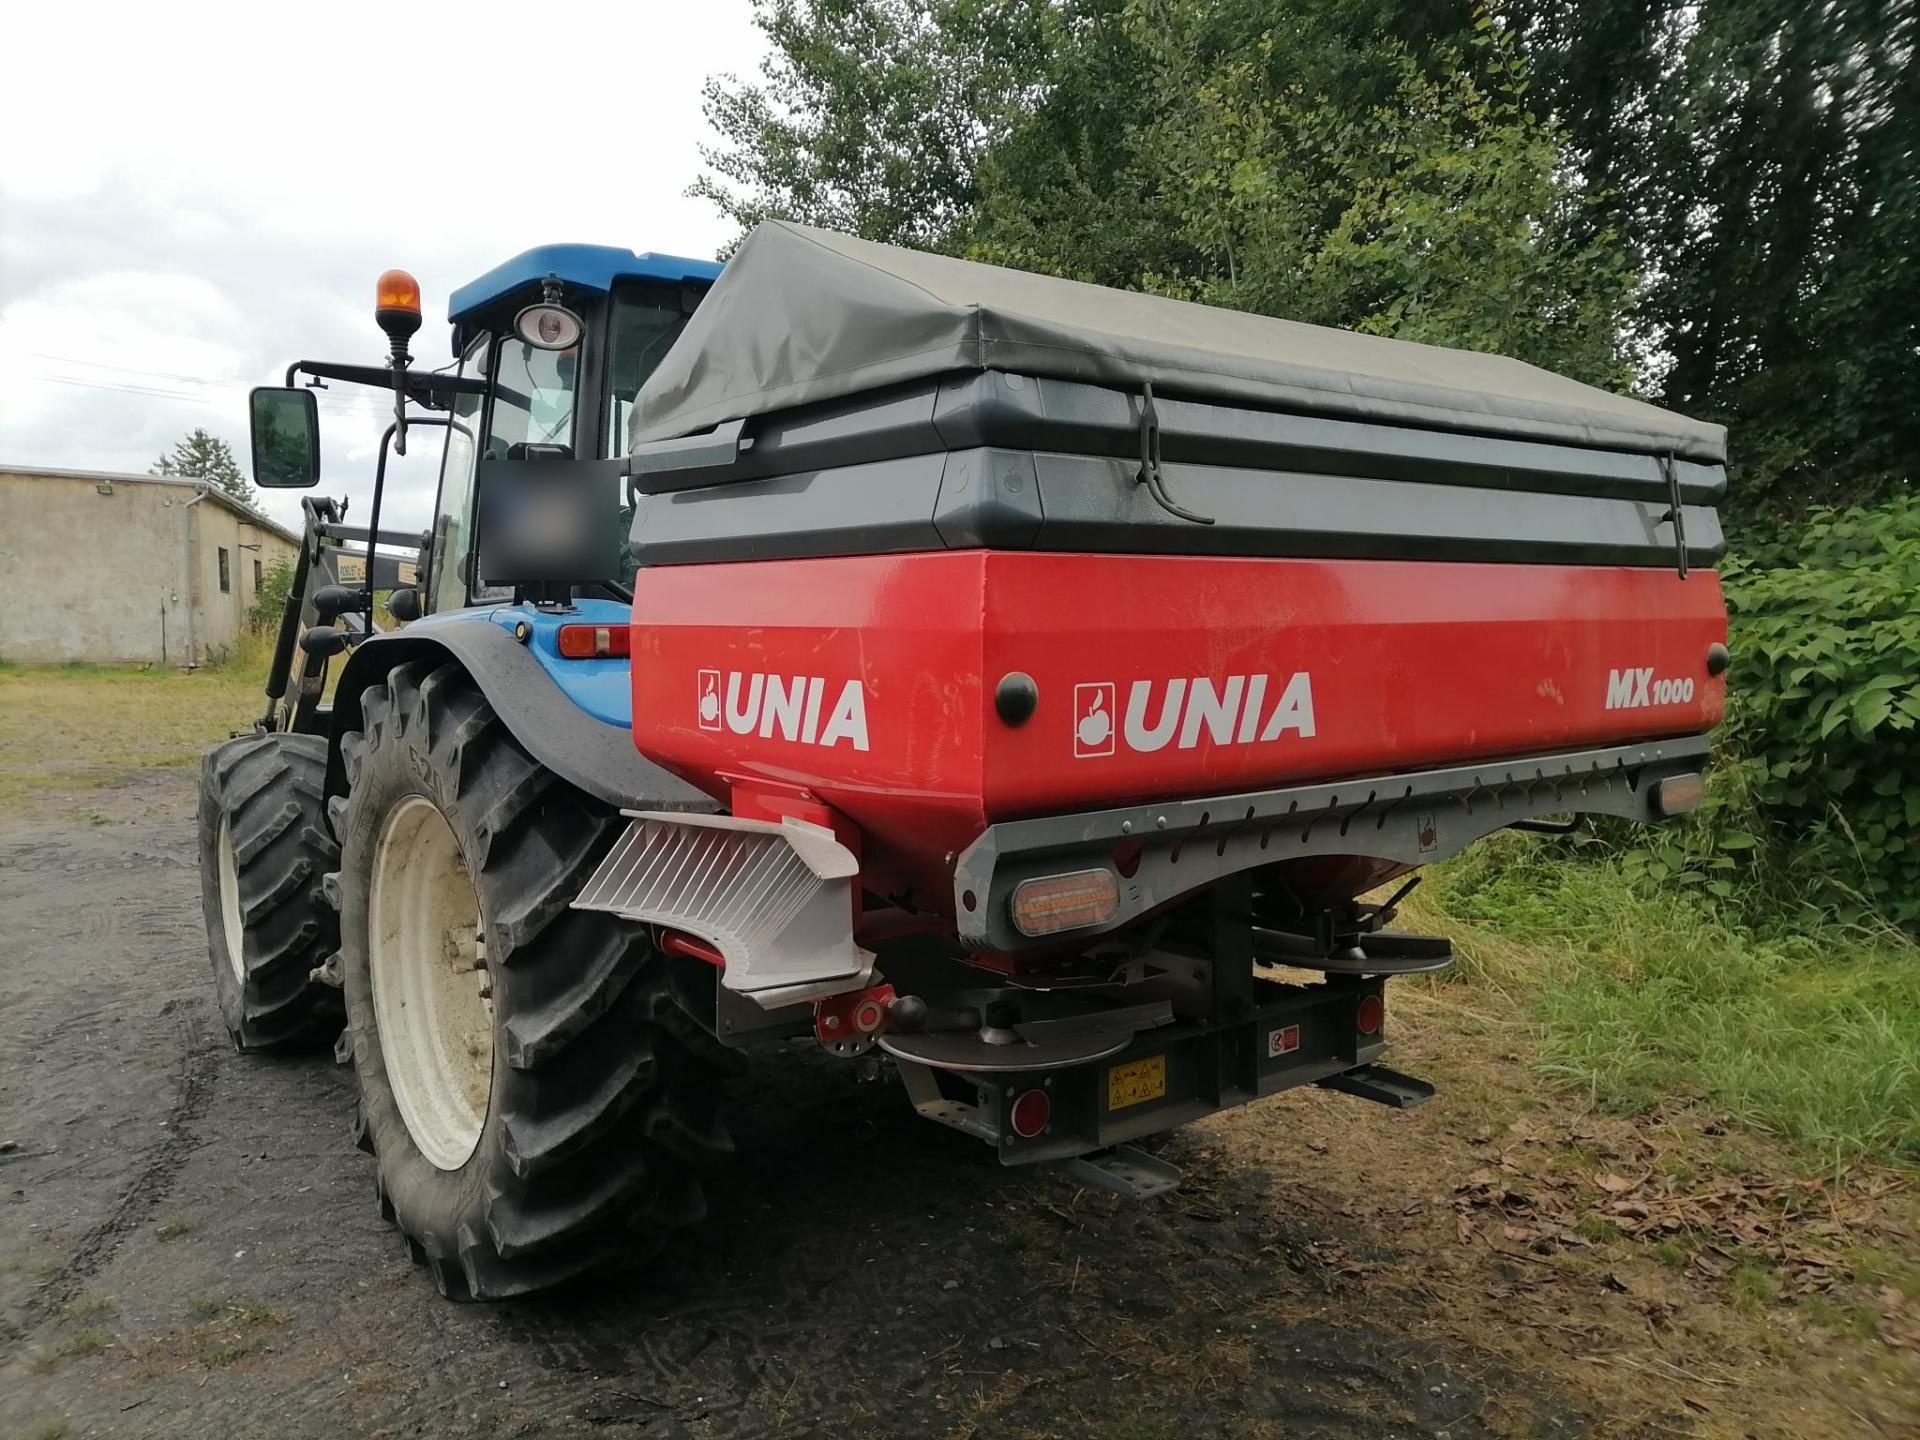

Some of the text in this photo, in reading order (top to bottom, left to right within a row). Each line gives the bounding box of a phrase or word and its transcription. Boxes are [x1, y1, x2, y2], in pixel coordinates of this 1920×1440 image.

[726, 671, 870, 751] UNIA
[1124, 672, 1316, 752] UNIA
[1605, 667, 1694, 709] MX 1000
